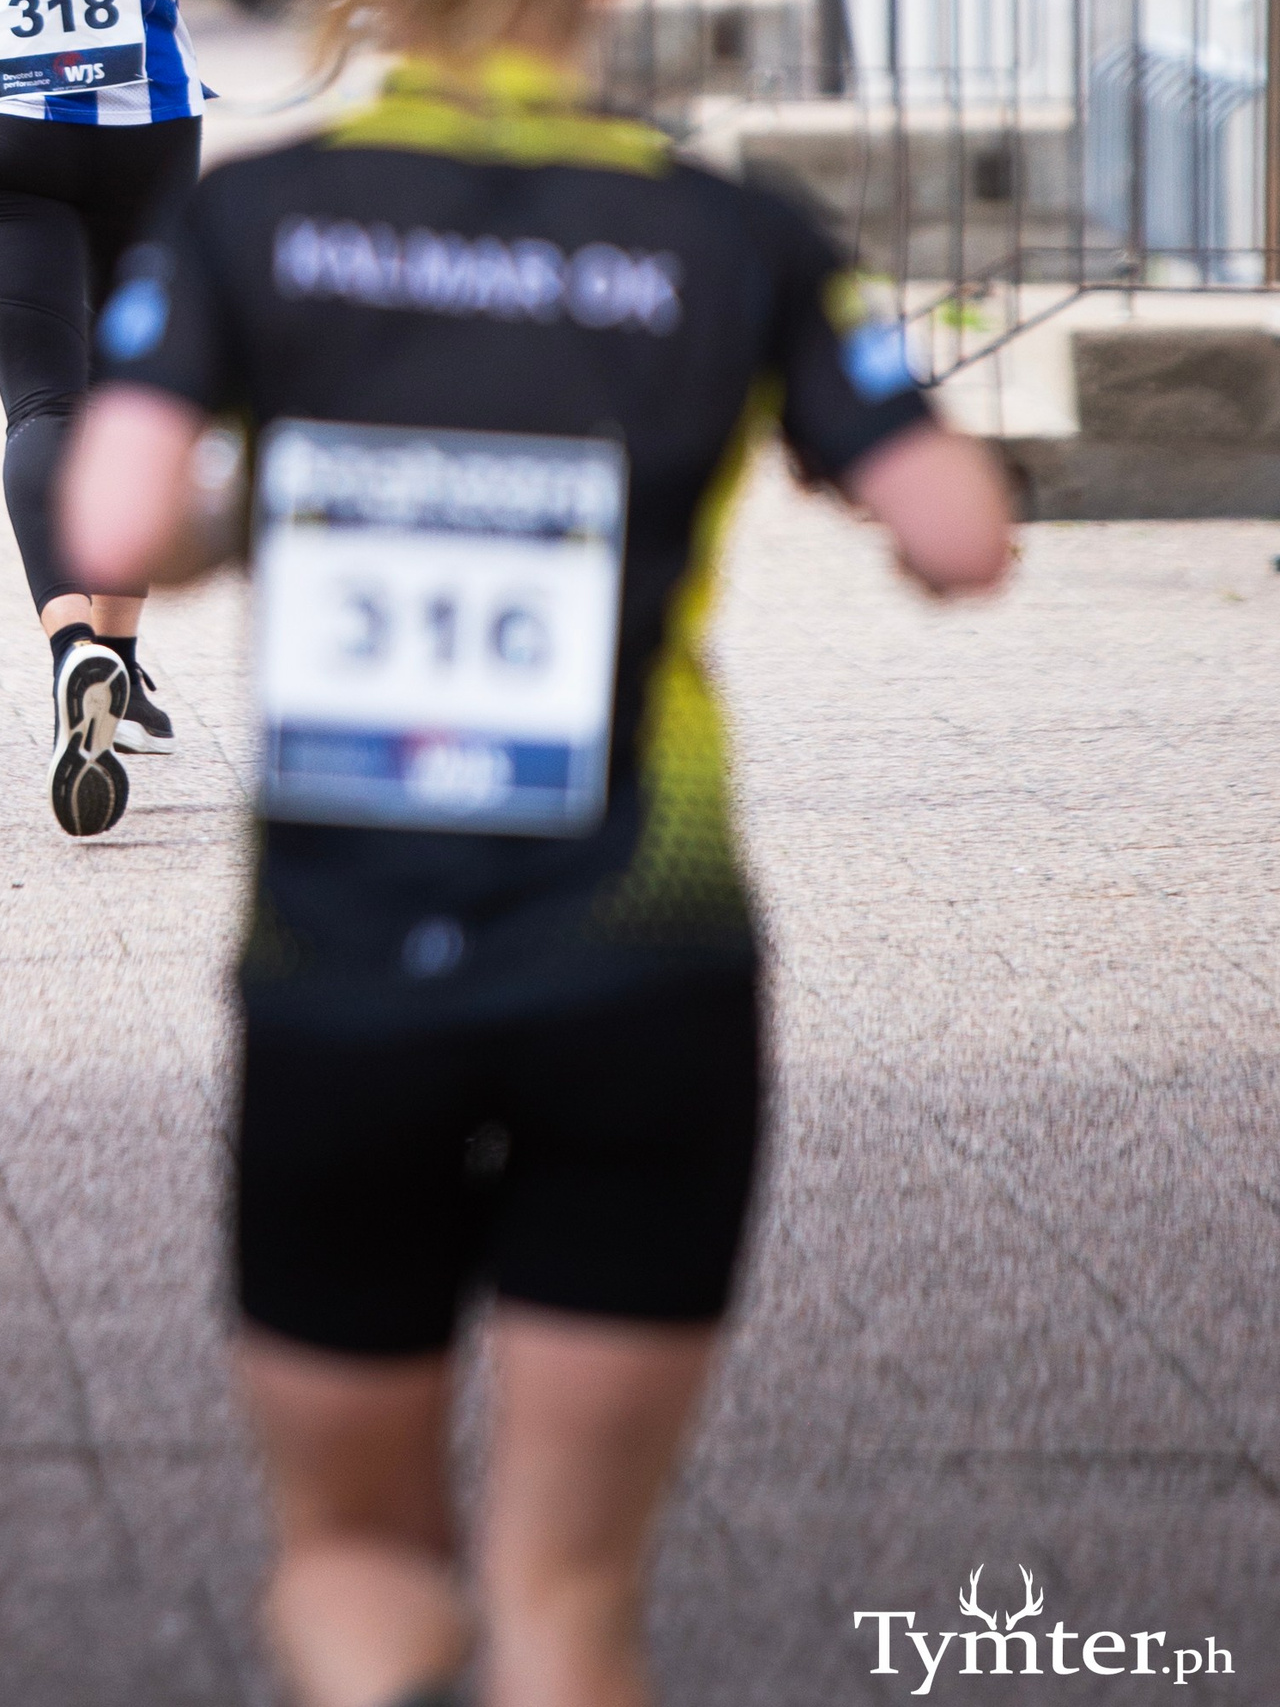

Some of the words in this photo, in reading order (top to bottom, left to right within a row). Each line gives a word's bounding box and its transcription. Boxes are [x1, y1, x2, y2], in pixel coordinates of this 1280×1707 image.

[2, 72, 33, 82] Devoted
[63, 62, 106, 84] WJS
[3, 78, 51, 90] performance
